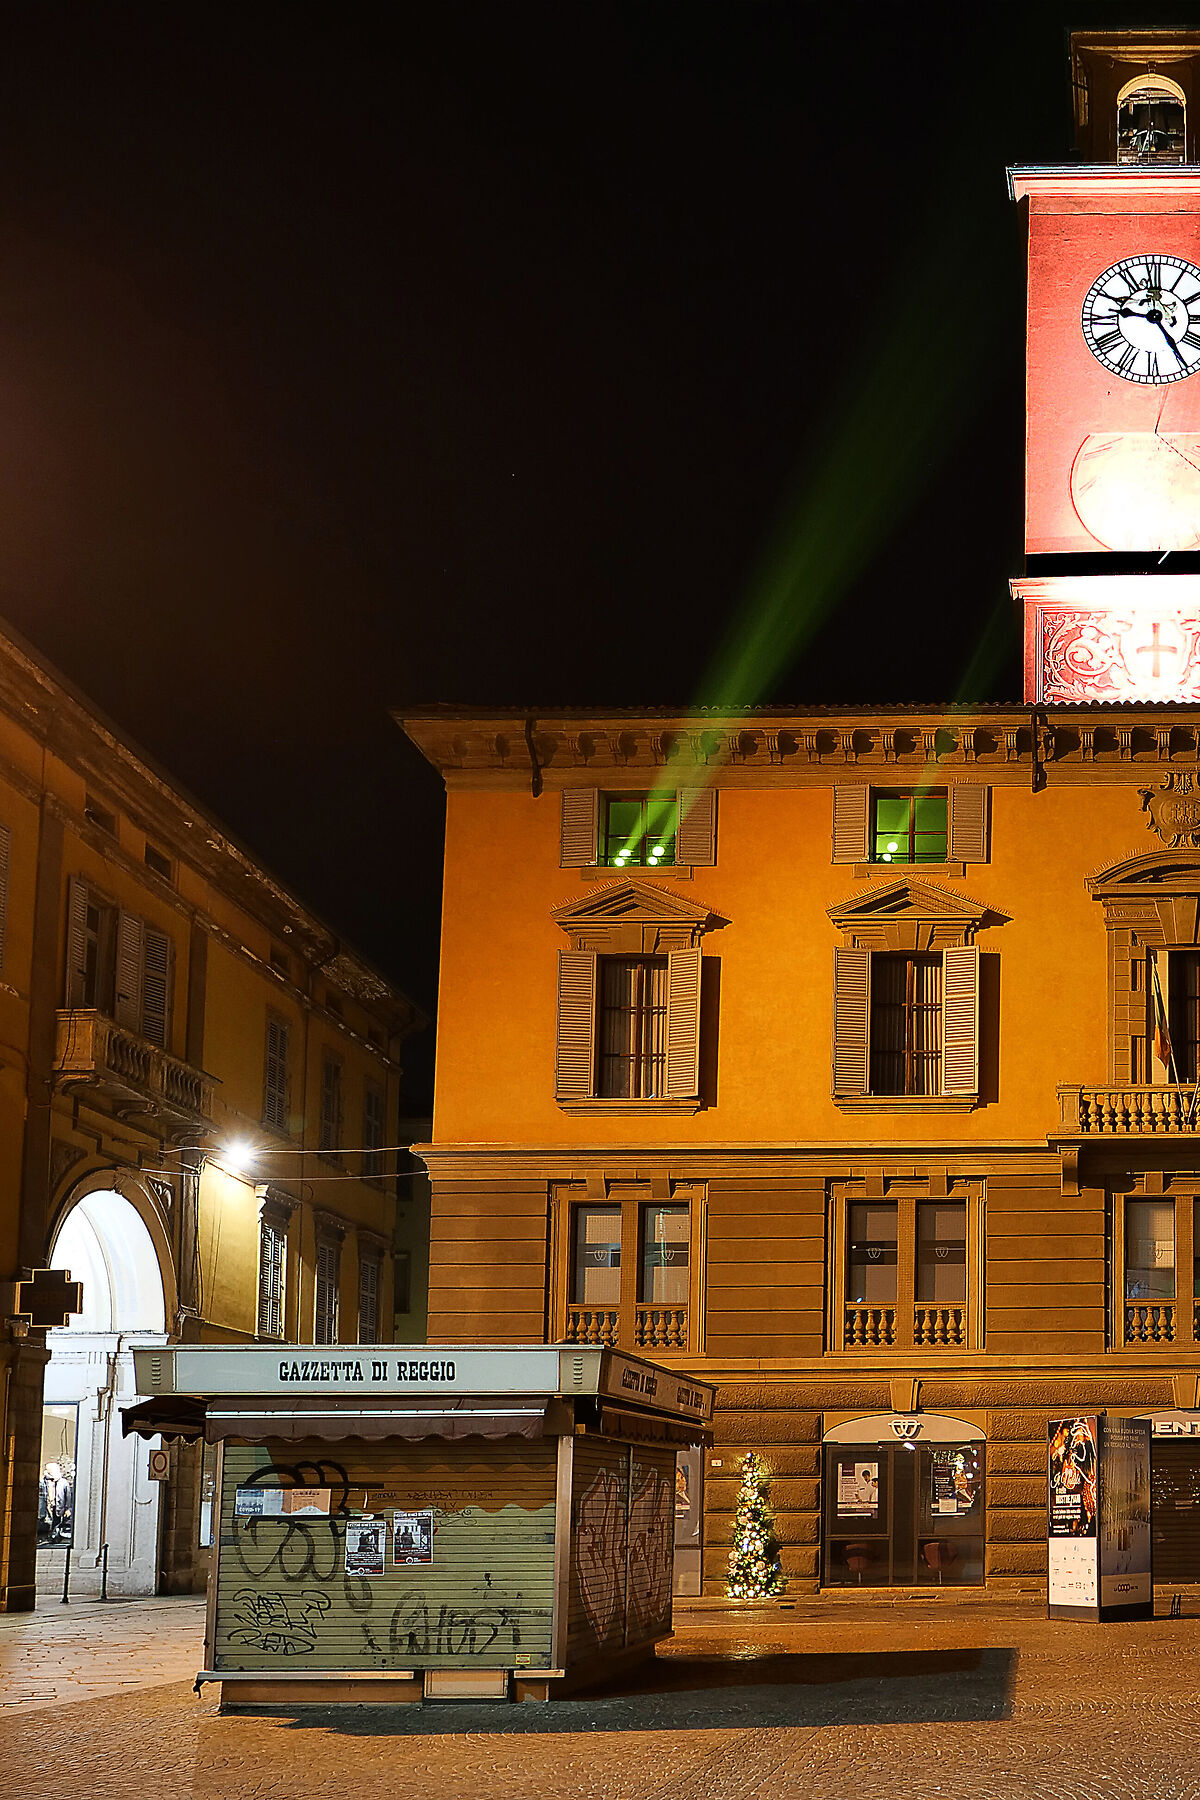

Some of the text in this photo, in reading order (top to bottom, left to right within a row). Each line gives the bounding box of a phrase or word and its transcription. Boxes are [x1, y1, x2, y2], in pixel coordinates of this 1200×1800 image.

[279, 1361, 456, 1381] GAZZETTA DI REGGIO
